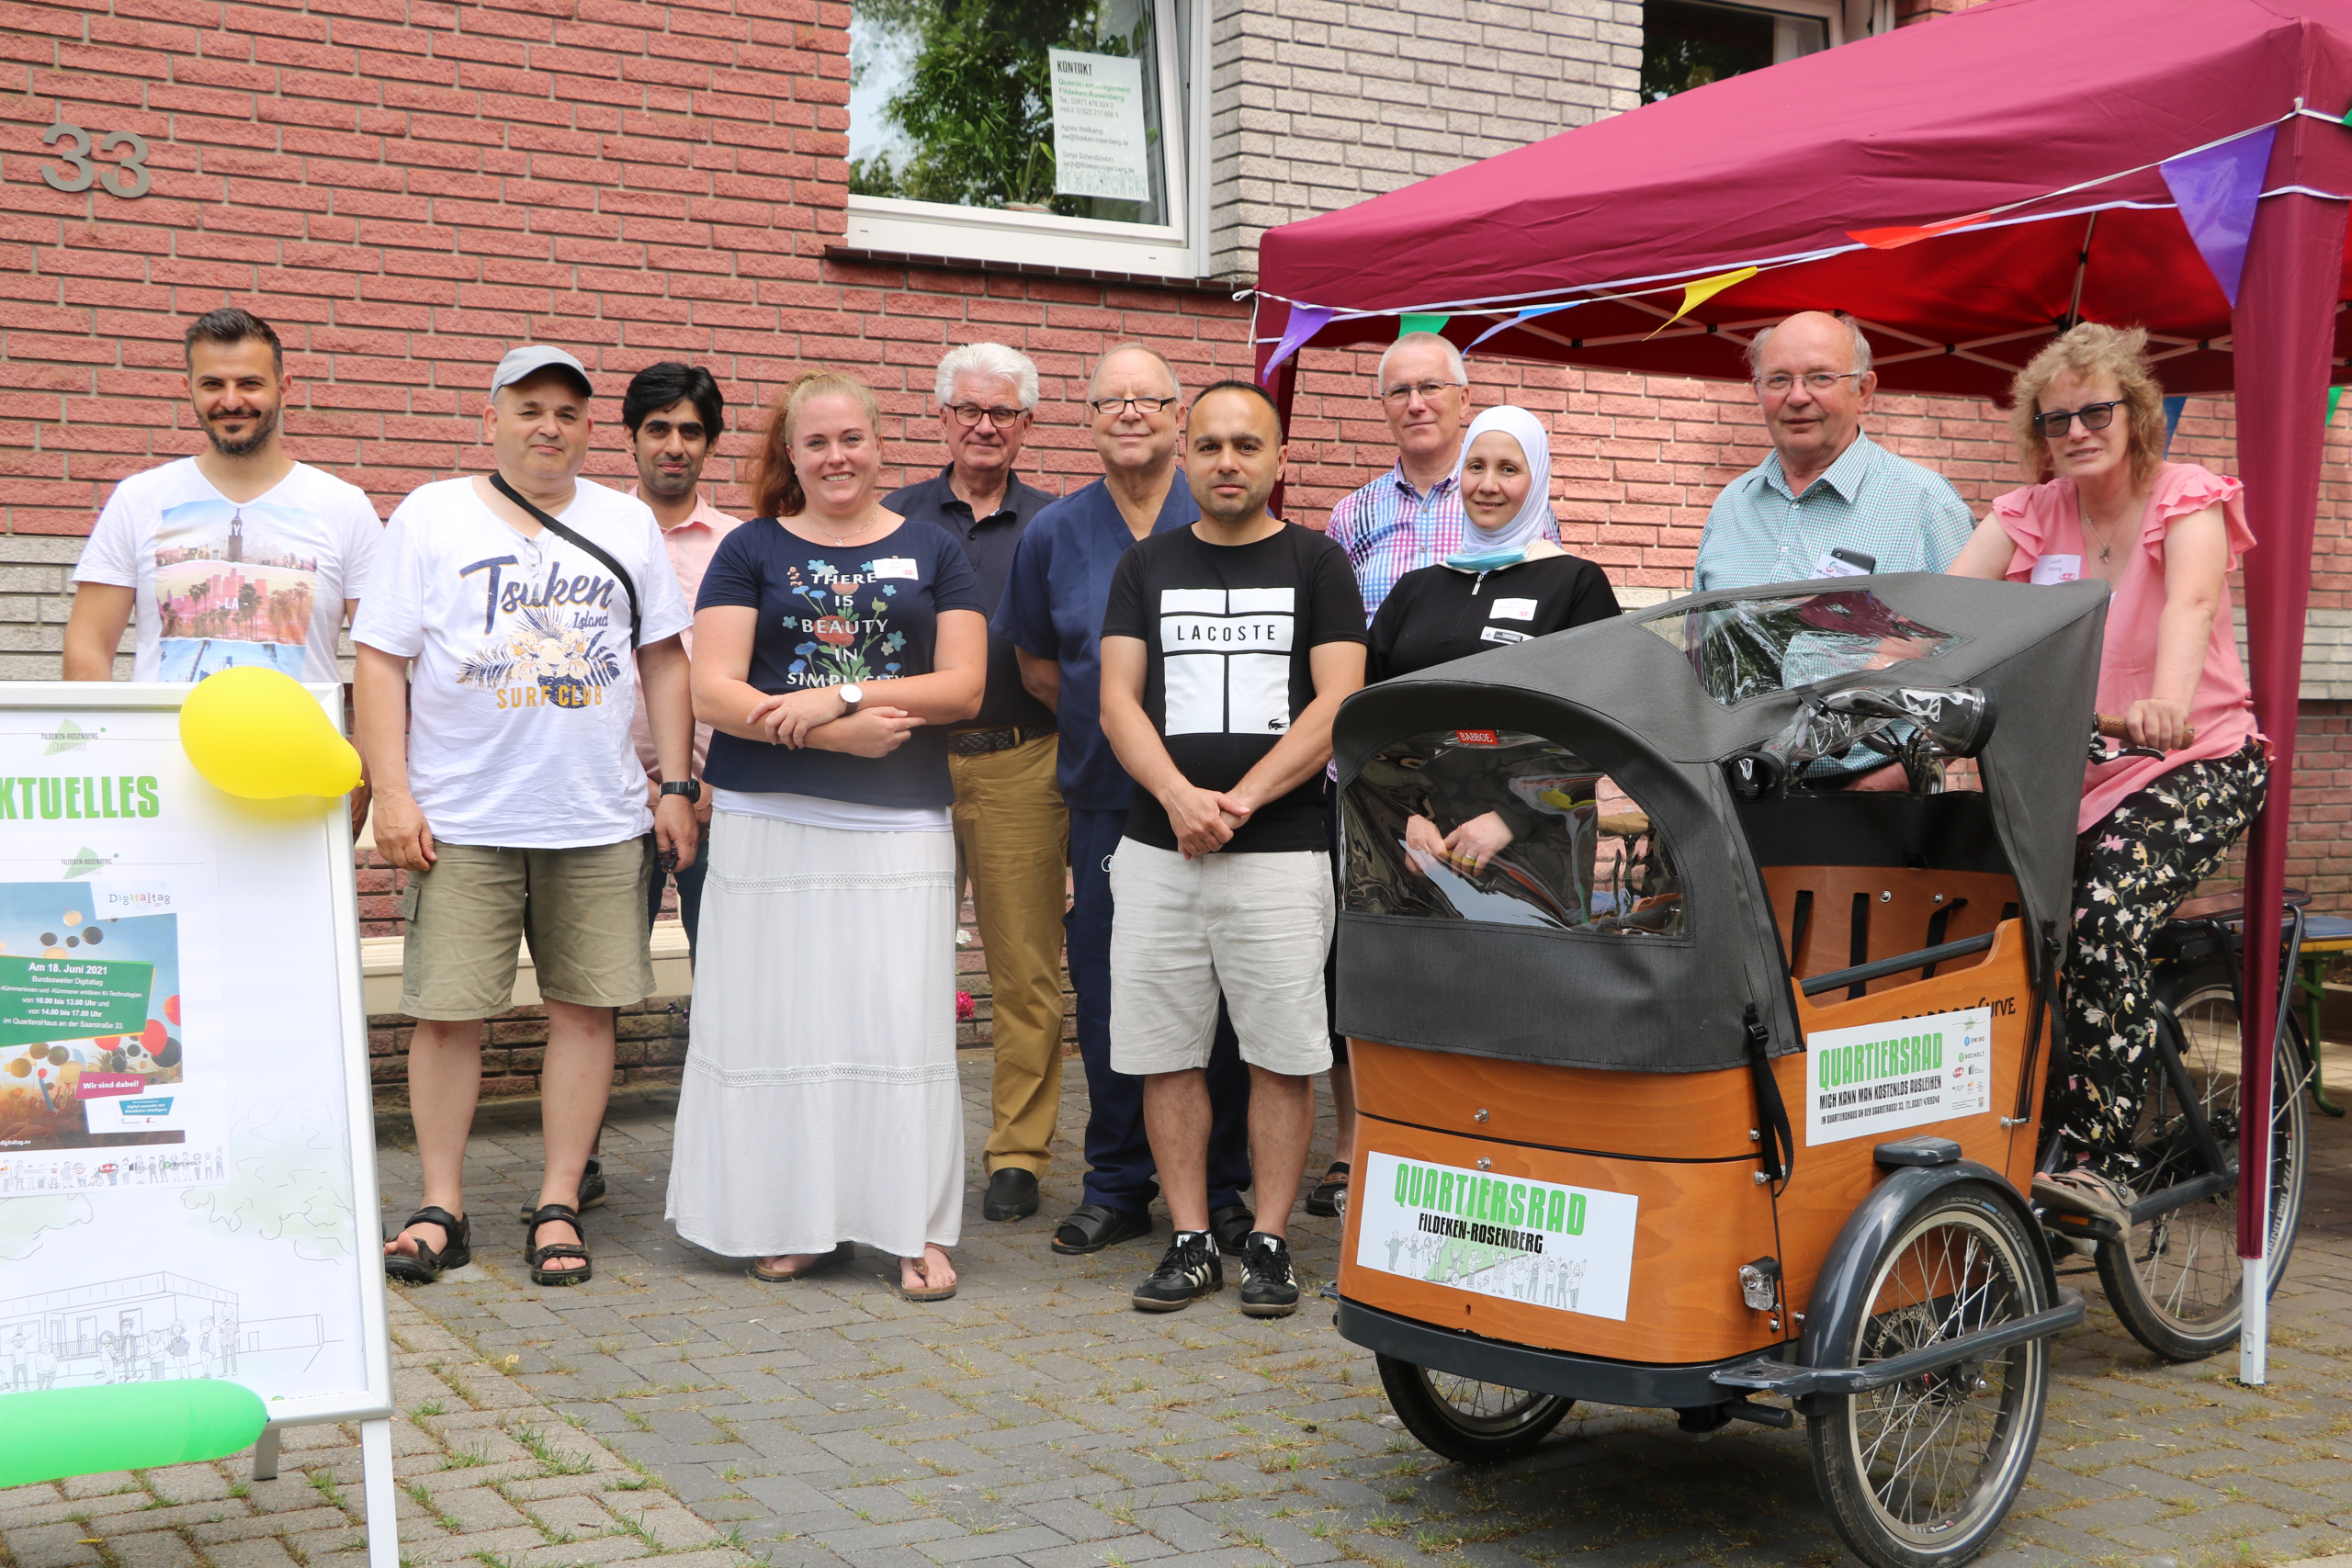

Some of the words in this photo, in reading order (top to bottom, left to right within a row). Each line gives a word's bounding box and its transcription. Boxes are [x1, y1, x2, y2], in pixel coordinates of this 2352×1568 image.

[1057, 60, 1092, 76] KONTAKT
[1058, 78, 1131, 93] Quartiersmanagement
[1059, 87, 1125, 102] Fildeken-Rosenberg
[1061, 124, 1078, 132] Agnes
[41, 124, 152, 198] 33
[1063, 151, 1078, 159] Sonja
[810, 572, 877, 585] THERE
[458, 554, 616, 636] Tsuken
[834, 595, 854, 607] IS
[572, 610, 609, 629] Island
[801, 618, 888, 635] BEAUTY
[1177, 625, 1275, 641] LACOSTE
[834, 648, 858, 661] IN
[496, 685, 551, 709] SURF
[558, 684, 603, 706] CLUB
[1459, 731, 1493, 743] BABBOE
[108, 892, 171, 906] Digitaltag
[28, 963, 45, 972] Am
[48, 964, 61, 973] 18.
[63, 964, 84, 974] Juni
[86, 965, 107, 975] 2021
[32, 976, 74, 985] Bundesweiter
[75, 977, 103, 987] Digitaltag
[102, 990, 142, 998] KI-Technologien
[13, 1018, 57, 1027] QuartiersHaus
[80, 1021, 113, 1029] Saarstraße
[1818, 1032, 1942, 1091] QUARTIERSRAD
[1965, 1051, 1984, 1059] BOCHOLT
[116, 1080, 139, 1089] dabei!
[1819, 1093, 1837, 1110] MICH
[1838, 1089, 1857, 1107] KANN
[1858, 1087, 1872, 1103] MAN
[1874, 1080, 1908, 1100] KOSTENLOS
[1910, 1074, 1942, 1094] AUSLEIHEN
[1821, 1115, 1826, 1125] IM
[1826, 1110, 1858, 1124] QUARTIERSHAUS
[1858, 1109, 1863, 1118] AN
[1872, 1102, 1898, 1115] SAARSTRASSE
[1394, 1162, 1587, 1236] QUARTIERSRAD
[1418, 1213, 1544, 1254] FILDEKEN-ROSENBERG
[1996, 1212, 2007, 1222] BIG
[2006, 1222, 2021, 1241] APPLE
